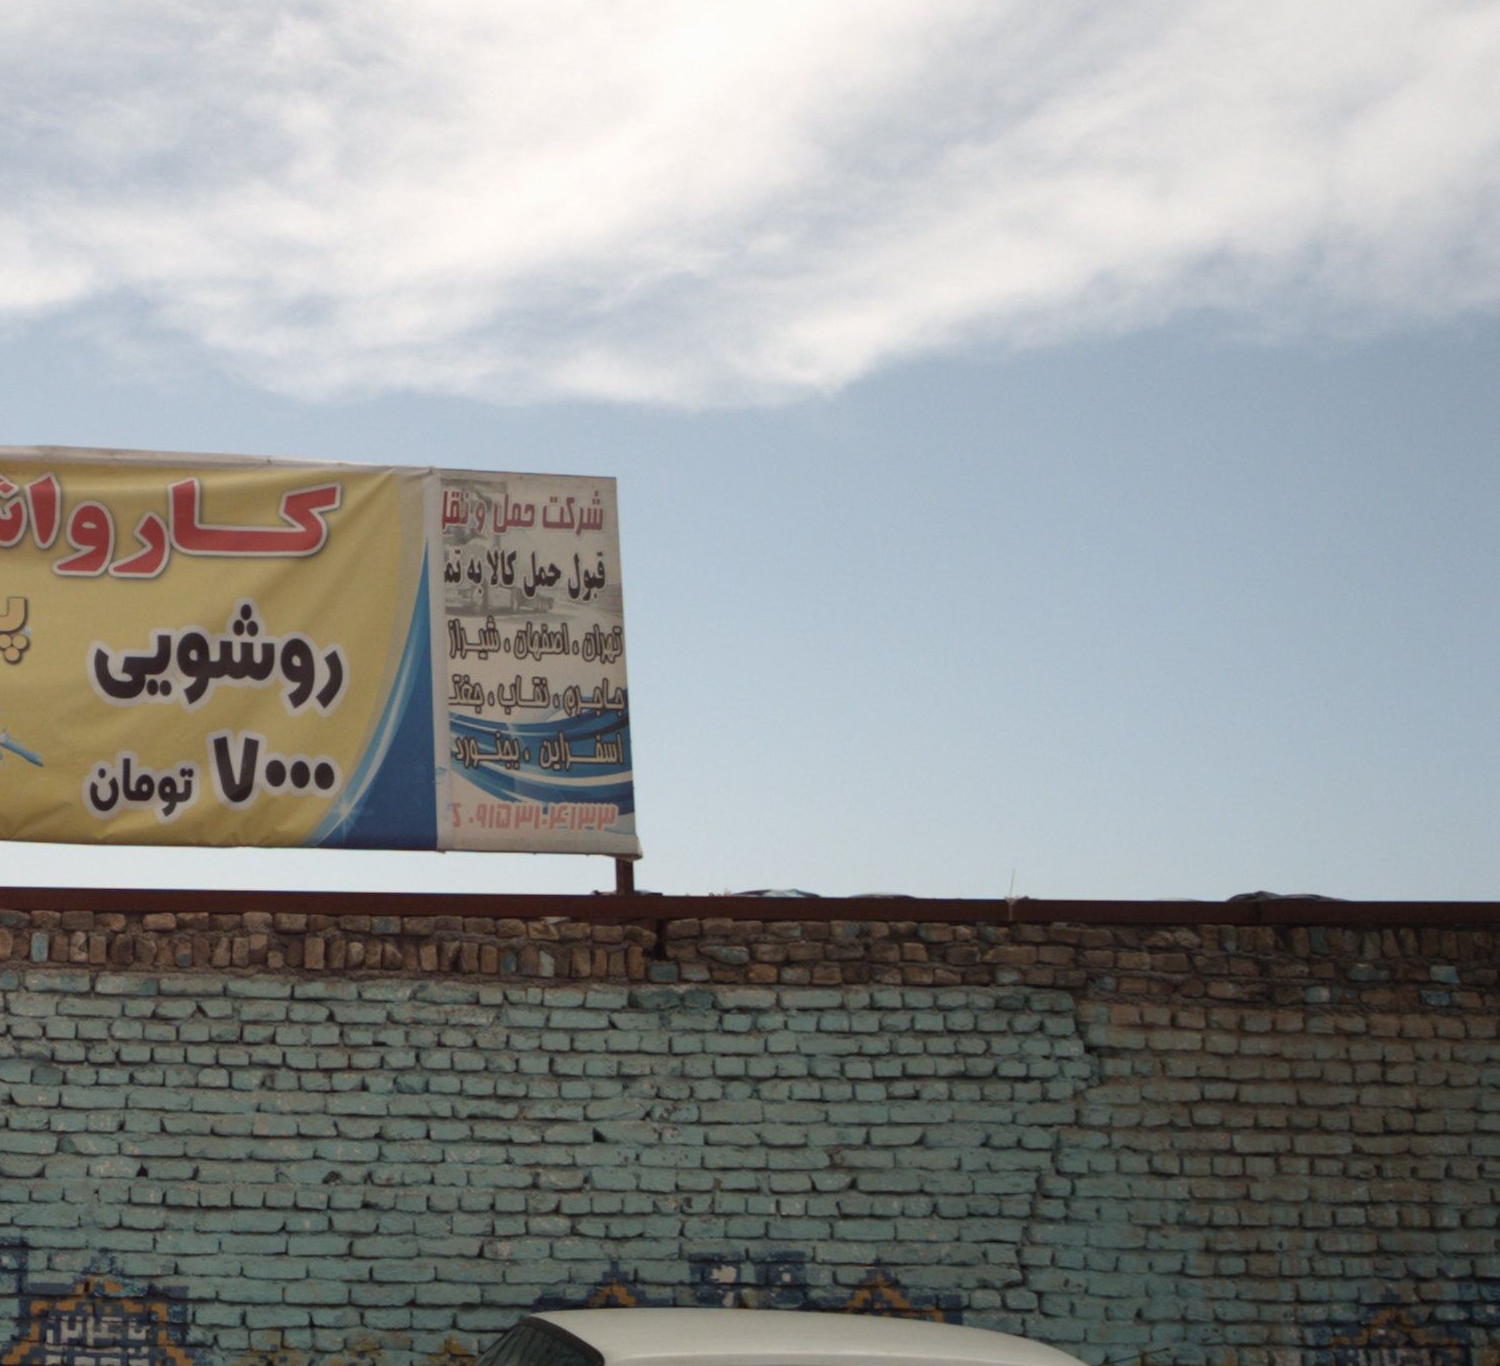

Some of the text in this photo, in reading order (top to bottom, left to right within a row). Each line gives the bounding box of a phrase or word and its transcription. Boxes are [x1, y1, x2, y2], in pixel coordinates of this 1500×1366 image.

[476, 499, 486, 533] و
[493, 493, 536, 534] حمل
[542, 490, 604, 537] شرکت
[466, 556, 483, 595] به
[487, 550, 517, 586] کالا
[524, 551, 562, 598] حمل
[568, 551, 606, 602] قبول
[94, 603, 344, 710] روشویی
[448, 615, 501, 660] شیراز
[89, 757, 195, 818] تومان
